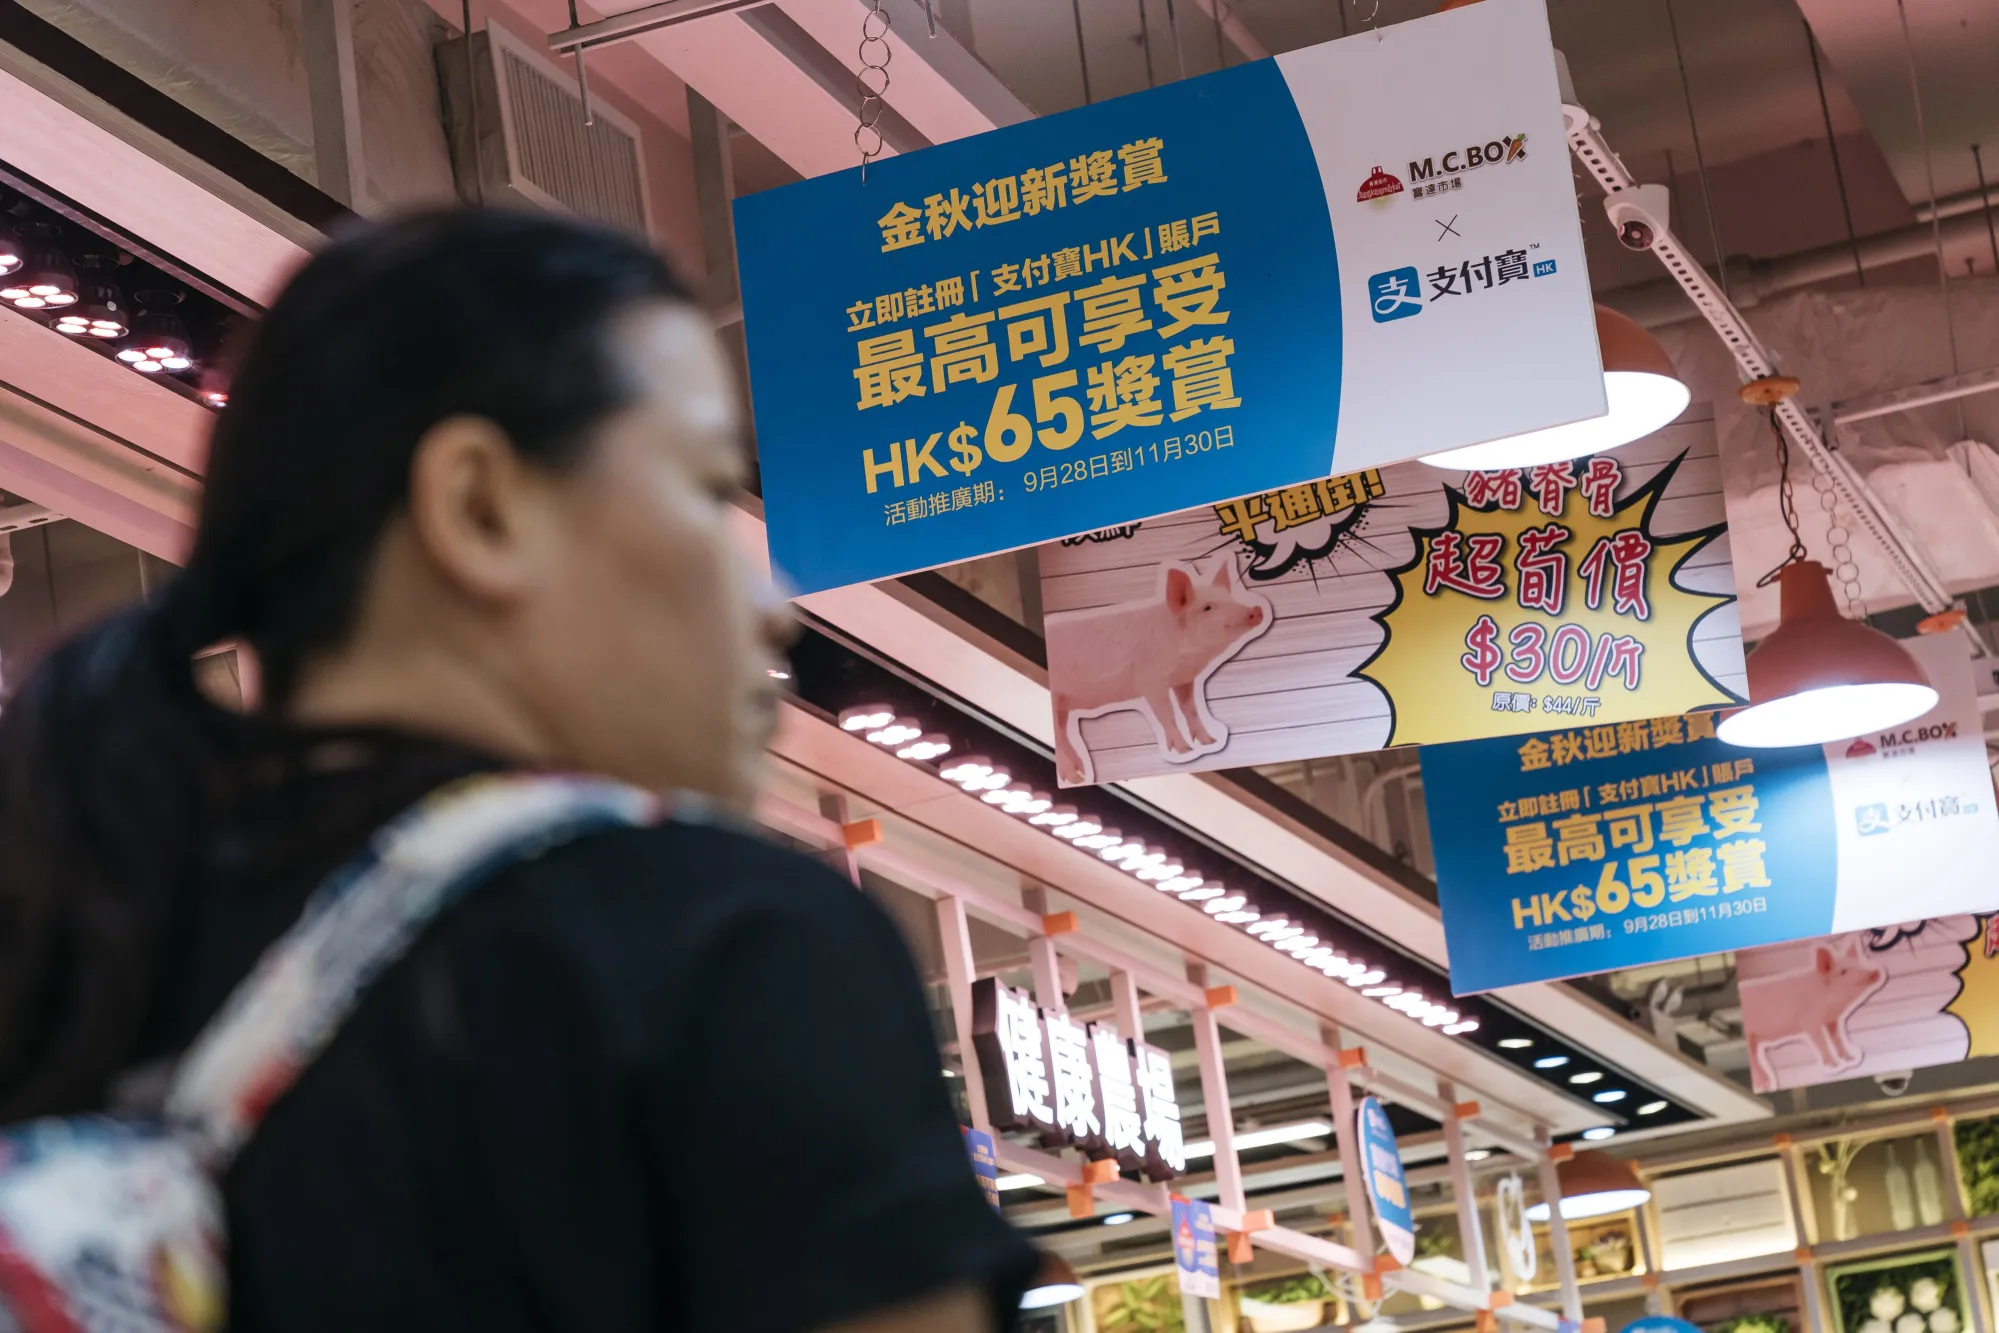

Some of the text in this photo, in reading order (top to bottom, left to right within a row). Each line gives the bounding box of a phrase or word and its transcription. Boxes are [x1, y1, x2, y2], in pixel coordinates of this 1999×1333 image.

[877, 137, 1168, 253] 金秋迎新獎賞
[1409, 133, 1527, 182] M.C.BOX
[1426, 249, 1529, 302] 支付寶
[1535, 261, 1554, 275] HK
[853, 252, 1231, 411] 最高可享受
[863, 336, 1242, 494] HK$65獎賞
[1023, 425, 1234, 492] 9月28日到11月30日
[1461, 615, 1643, 690] $30/斤
[1543, 696, 1601, 717] $44/斤
[1503, 785, 1763, 875] 最高可享受
[1511, 838, 1772, 930] HK$65獎賞
